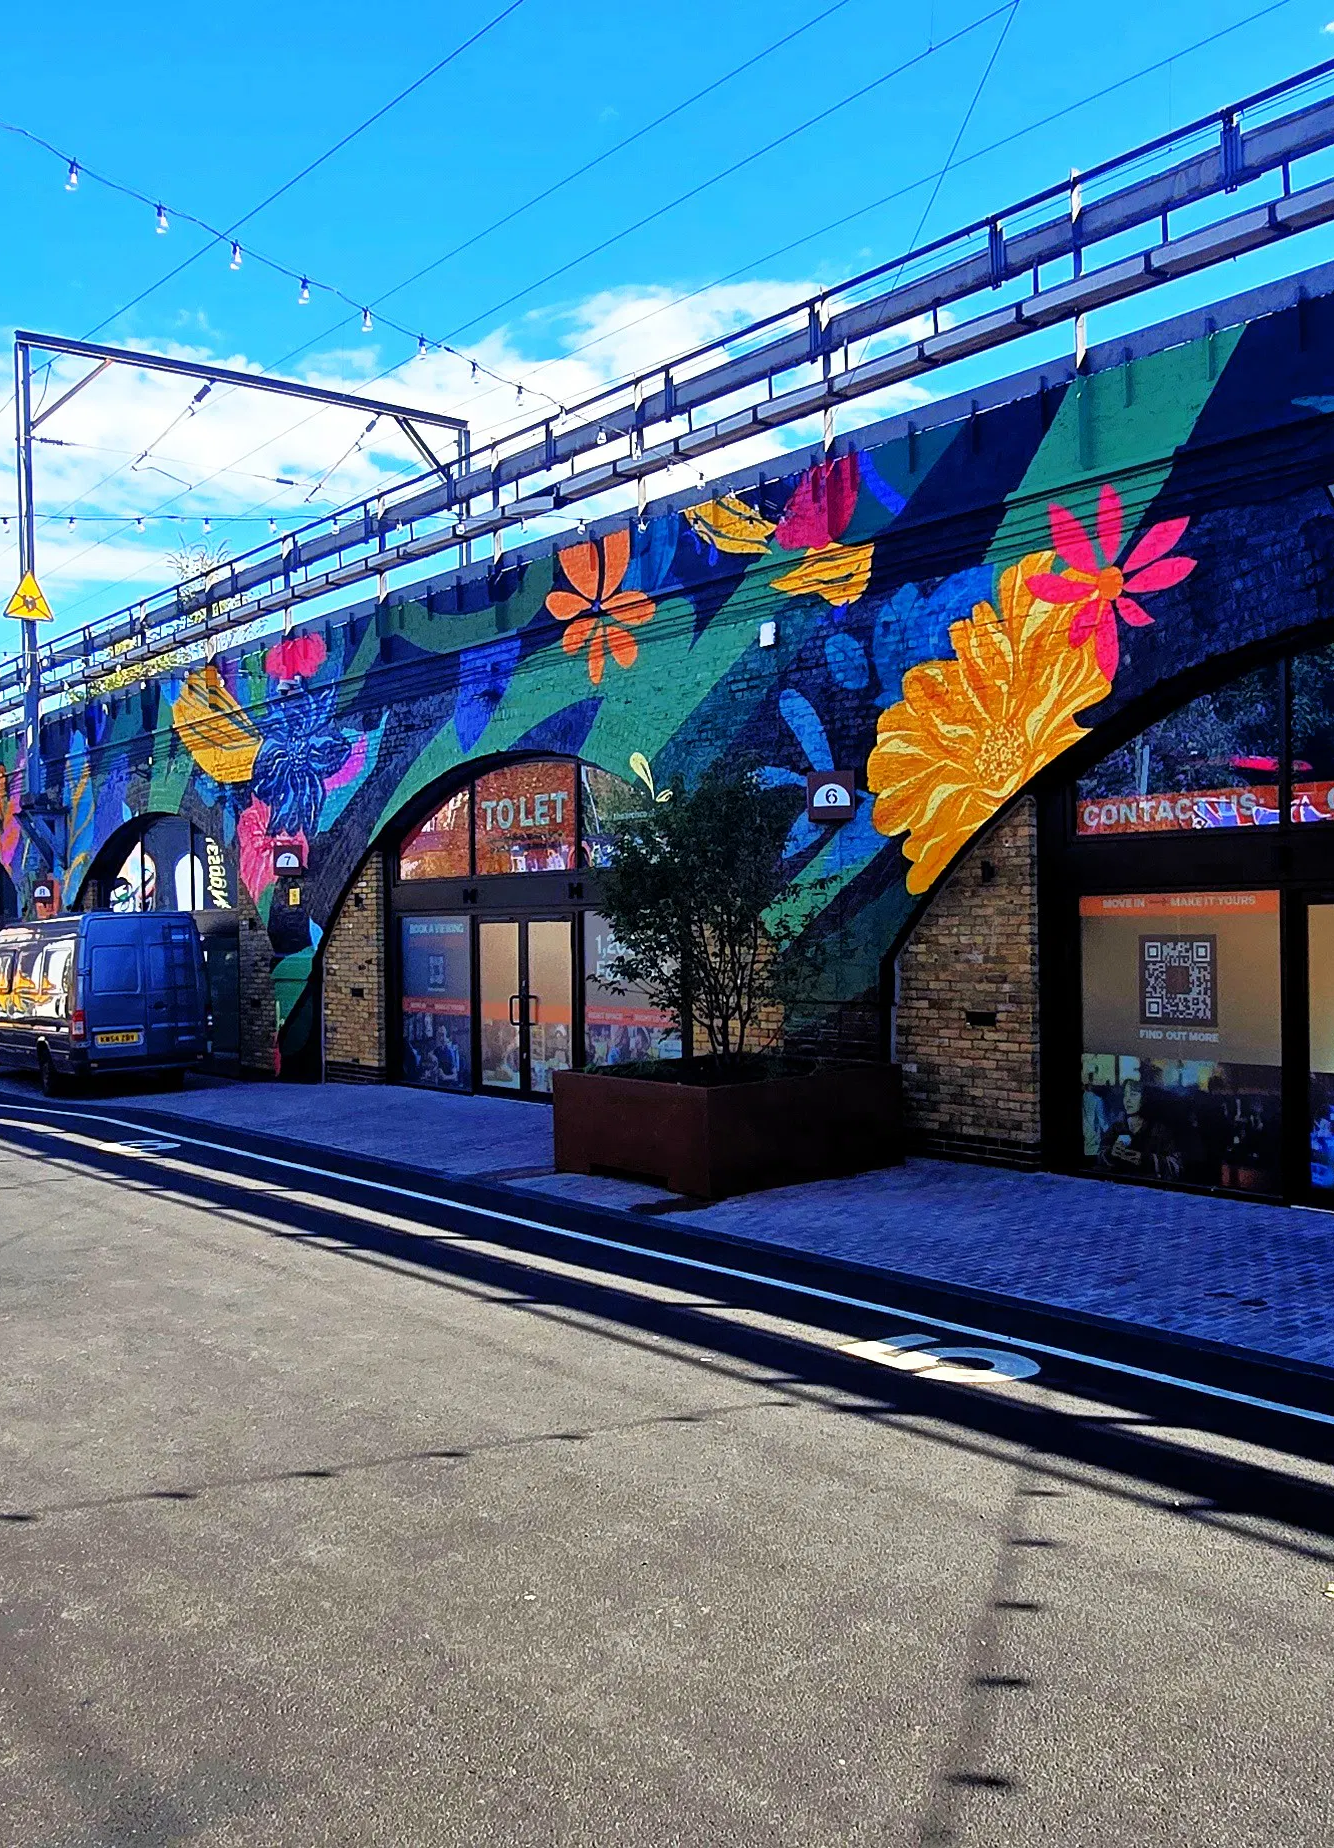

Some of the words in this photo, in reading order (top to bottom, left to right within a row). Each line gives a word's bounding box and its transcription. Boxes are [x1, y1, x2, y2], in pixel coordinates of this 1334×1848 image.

[825, 788, 838, 804] 6
[481, 799, 515, 831] TO
[519, 791, 568, 828] LET
[1082, 796, 1212, 827] CONTAC
[284, 855, 292, 866] 7
[1103, 899, 1131, 908] MOVE
[1133, 898, 1145, 908] IN
[1171, 897, 1202, 907] MAKE
[1203, 897, 1215, 906] IT
[1217, 896, 1256, 905] YOURS
[1139, 1029, 1163, 1040] FIND
[1166, 1031, 1187, 1041] OUT
[1188, 1032, 1219, 1043] MORE
